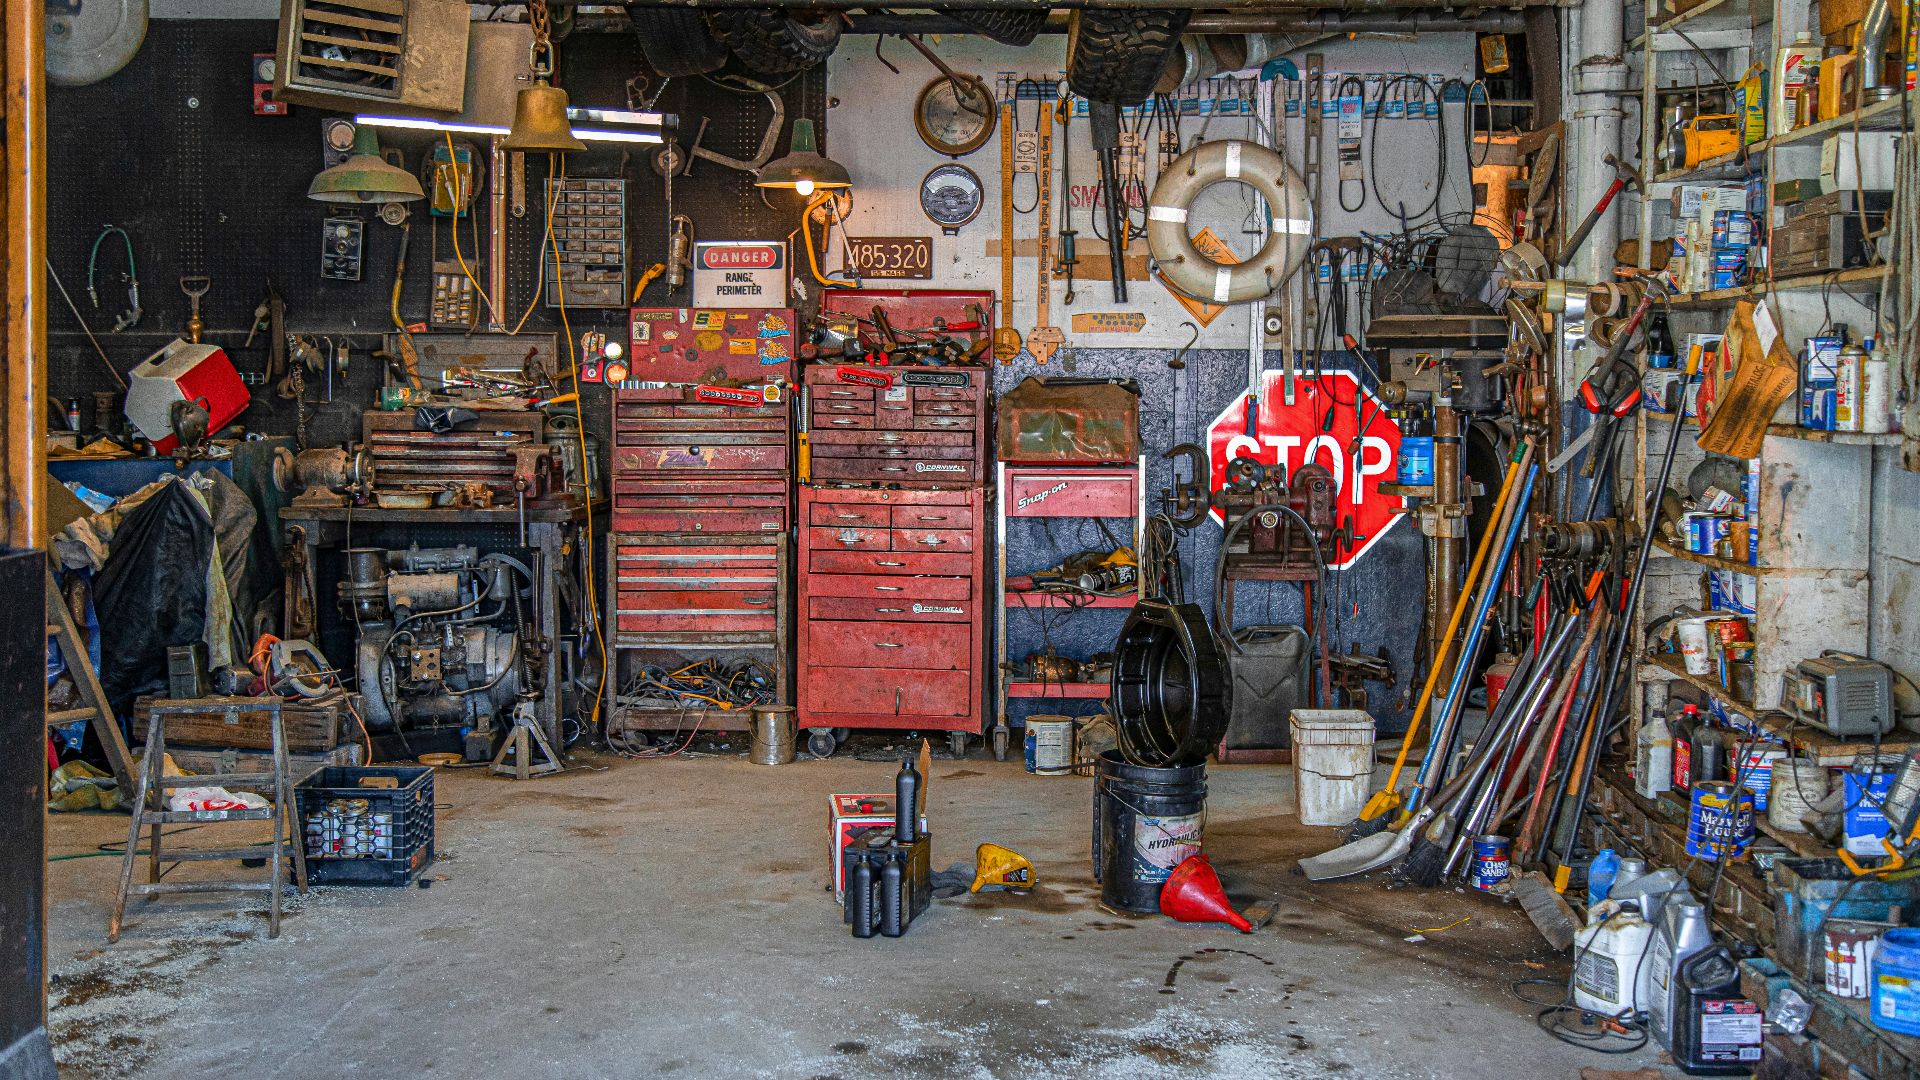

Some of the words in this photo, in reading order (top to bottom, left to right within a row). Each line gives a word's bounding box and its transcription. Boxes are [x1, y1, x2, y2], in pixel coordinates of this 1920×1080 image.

[1041, 135, 1050, 152] Keep
[1042, 153, 1050, 168] That
[1041, 189, 1049, 201] GM
[1041, 203, 1049, 226] Feeling
[1041, 228, 1049, 243] With
[710, 251, 769, 263] DANGER
[1041, 245, 1049, 272] Genuine
[725, 272, 754, 283] RANGE
[716, 285, 762, 296] PERIMETER
[1017, 481, 1069, 511] Snap-on
